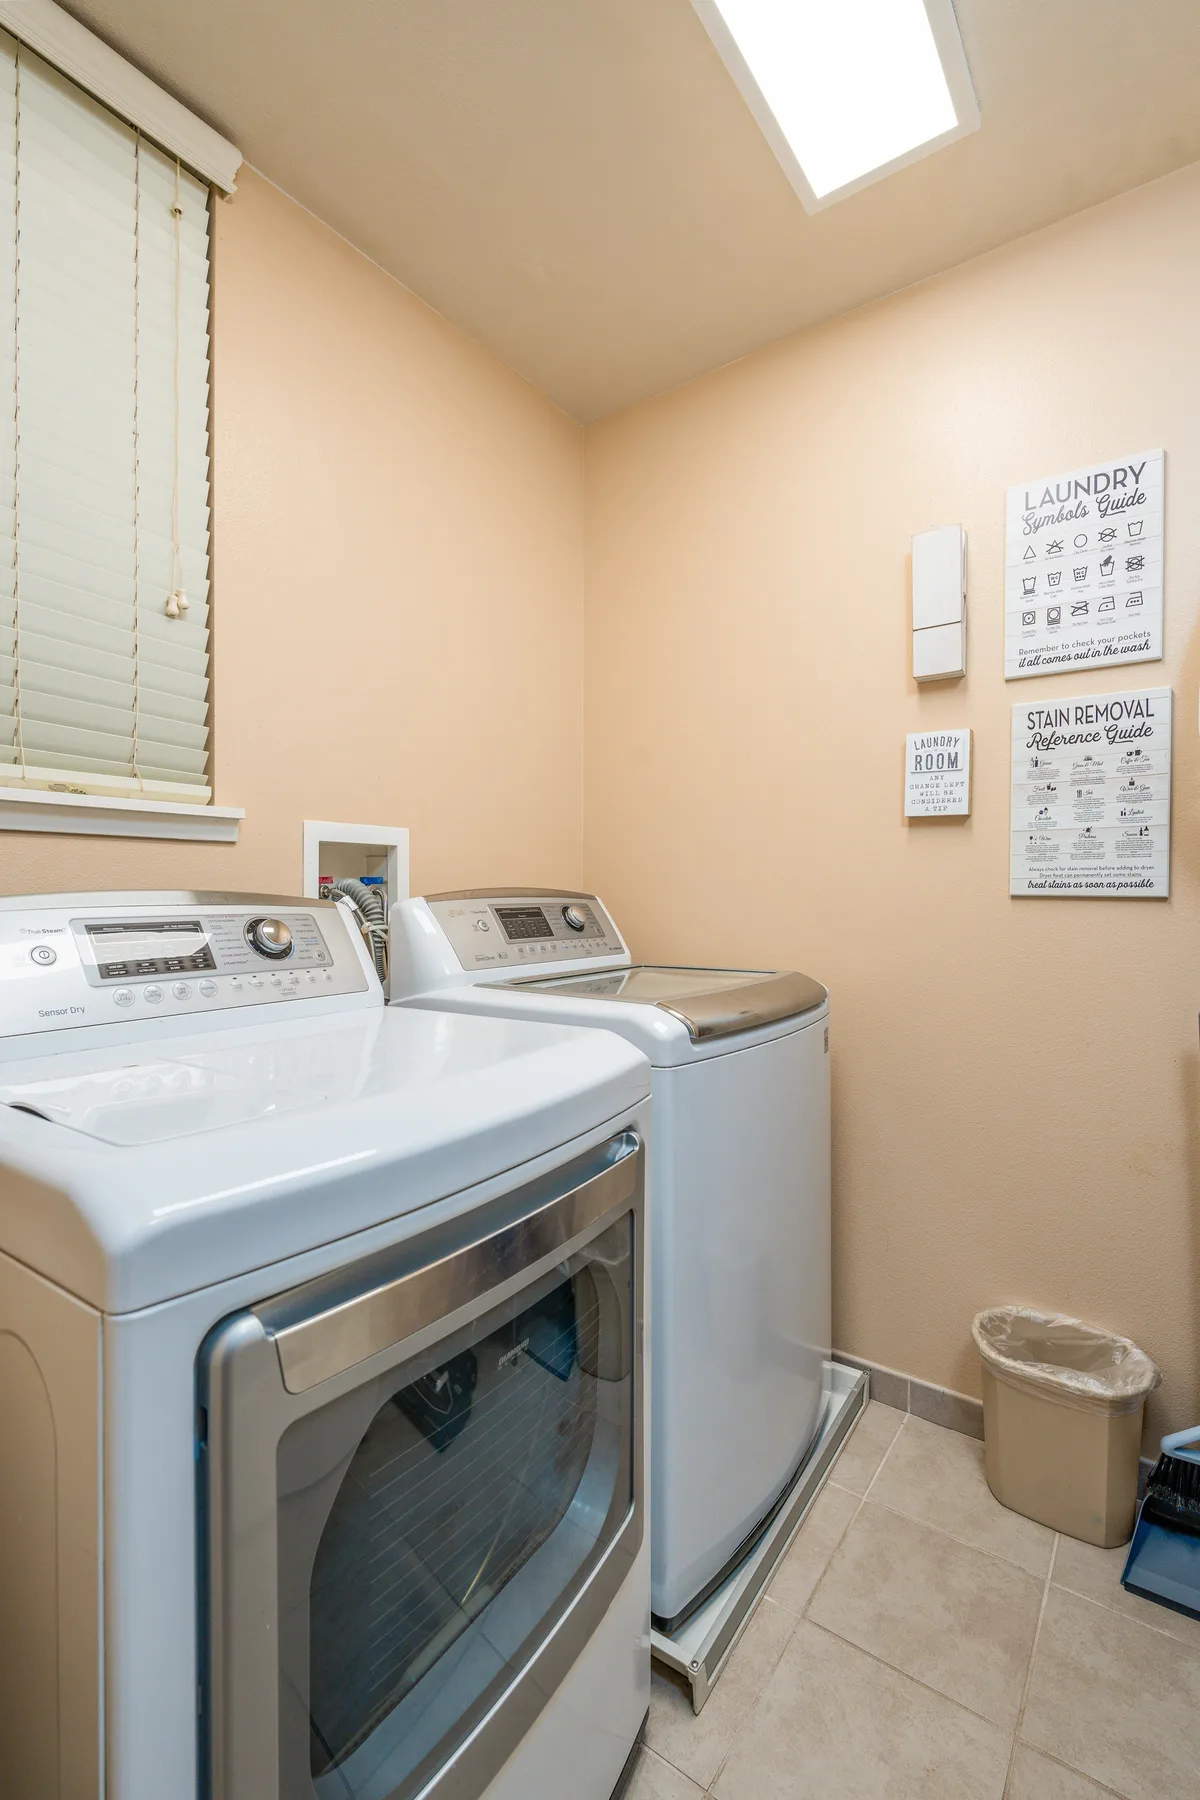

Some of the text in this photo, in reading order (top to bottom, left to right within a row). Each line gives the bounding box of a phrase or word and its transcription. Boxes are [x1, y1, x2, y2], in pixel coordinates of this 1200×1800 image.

[1025, 462, 1147, 511] LAUNDRY
[1022, 488, 1147, 536] Symbols Guide
[1019, 645, 1059, 656] Remember
[1072, 638, 1095, 648] check
[1097, 637, 1115, 646] your
[1118, 631, 1151, 642] pockets
[1019, 639, 1151, 668] it all comes out in the wash
[1027, 698, 1154, 730] STAIN REMOVAL
[914, 736, 960, 750] LAUNDRY
[1026, 722, 1154, 751] Reference Guide
[914, 752, 959, 771] ROOM
[1028, 880, 1047, 888] treat
[1048, 880, 1072, 888] stains
[1116, 879, 1155, 890] possible
[38, 1009, 68, 1018] Sensor
[499, 1338, 530, 1365] DIAMOND
